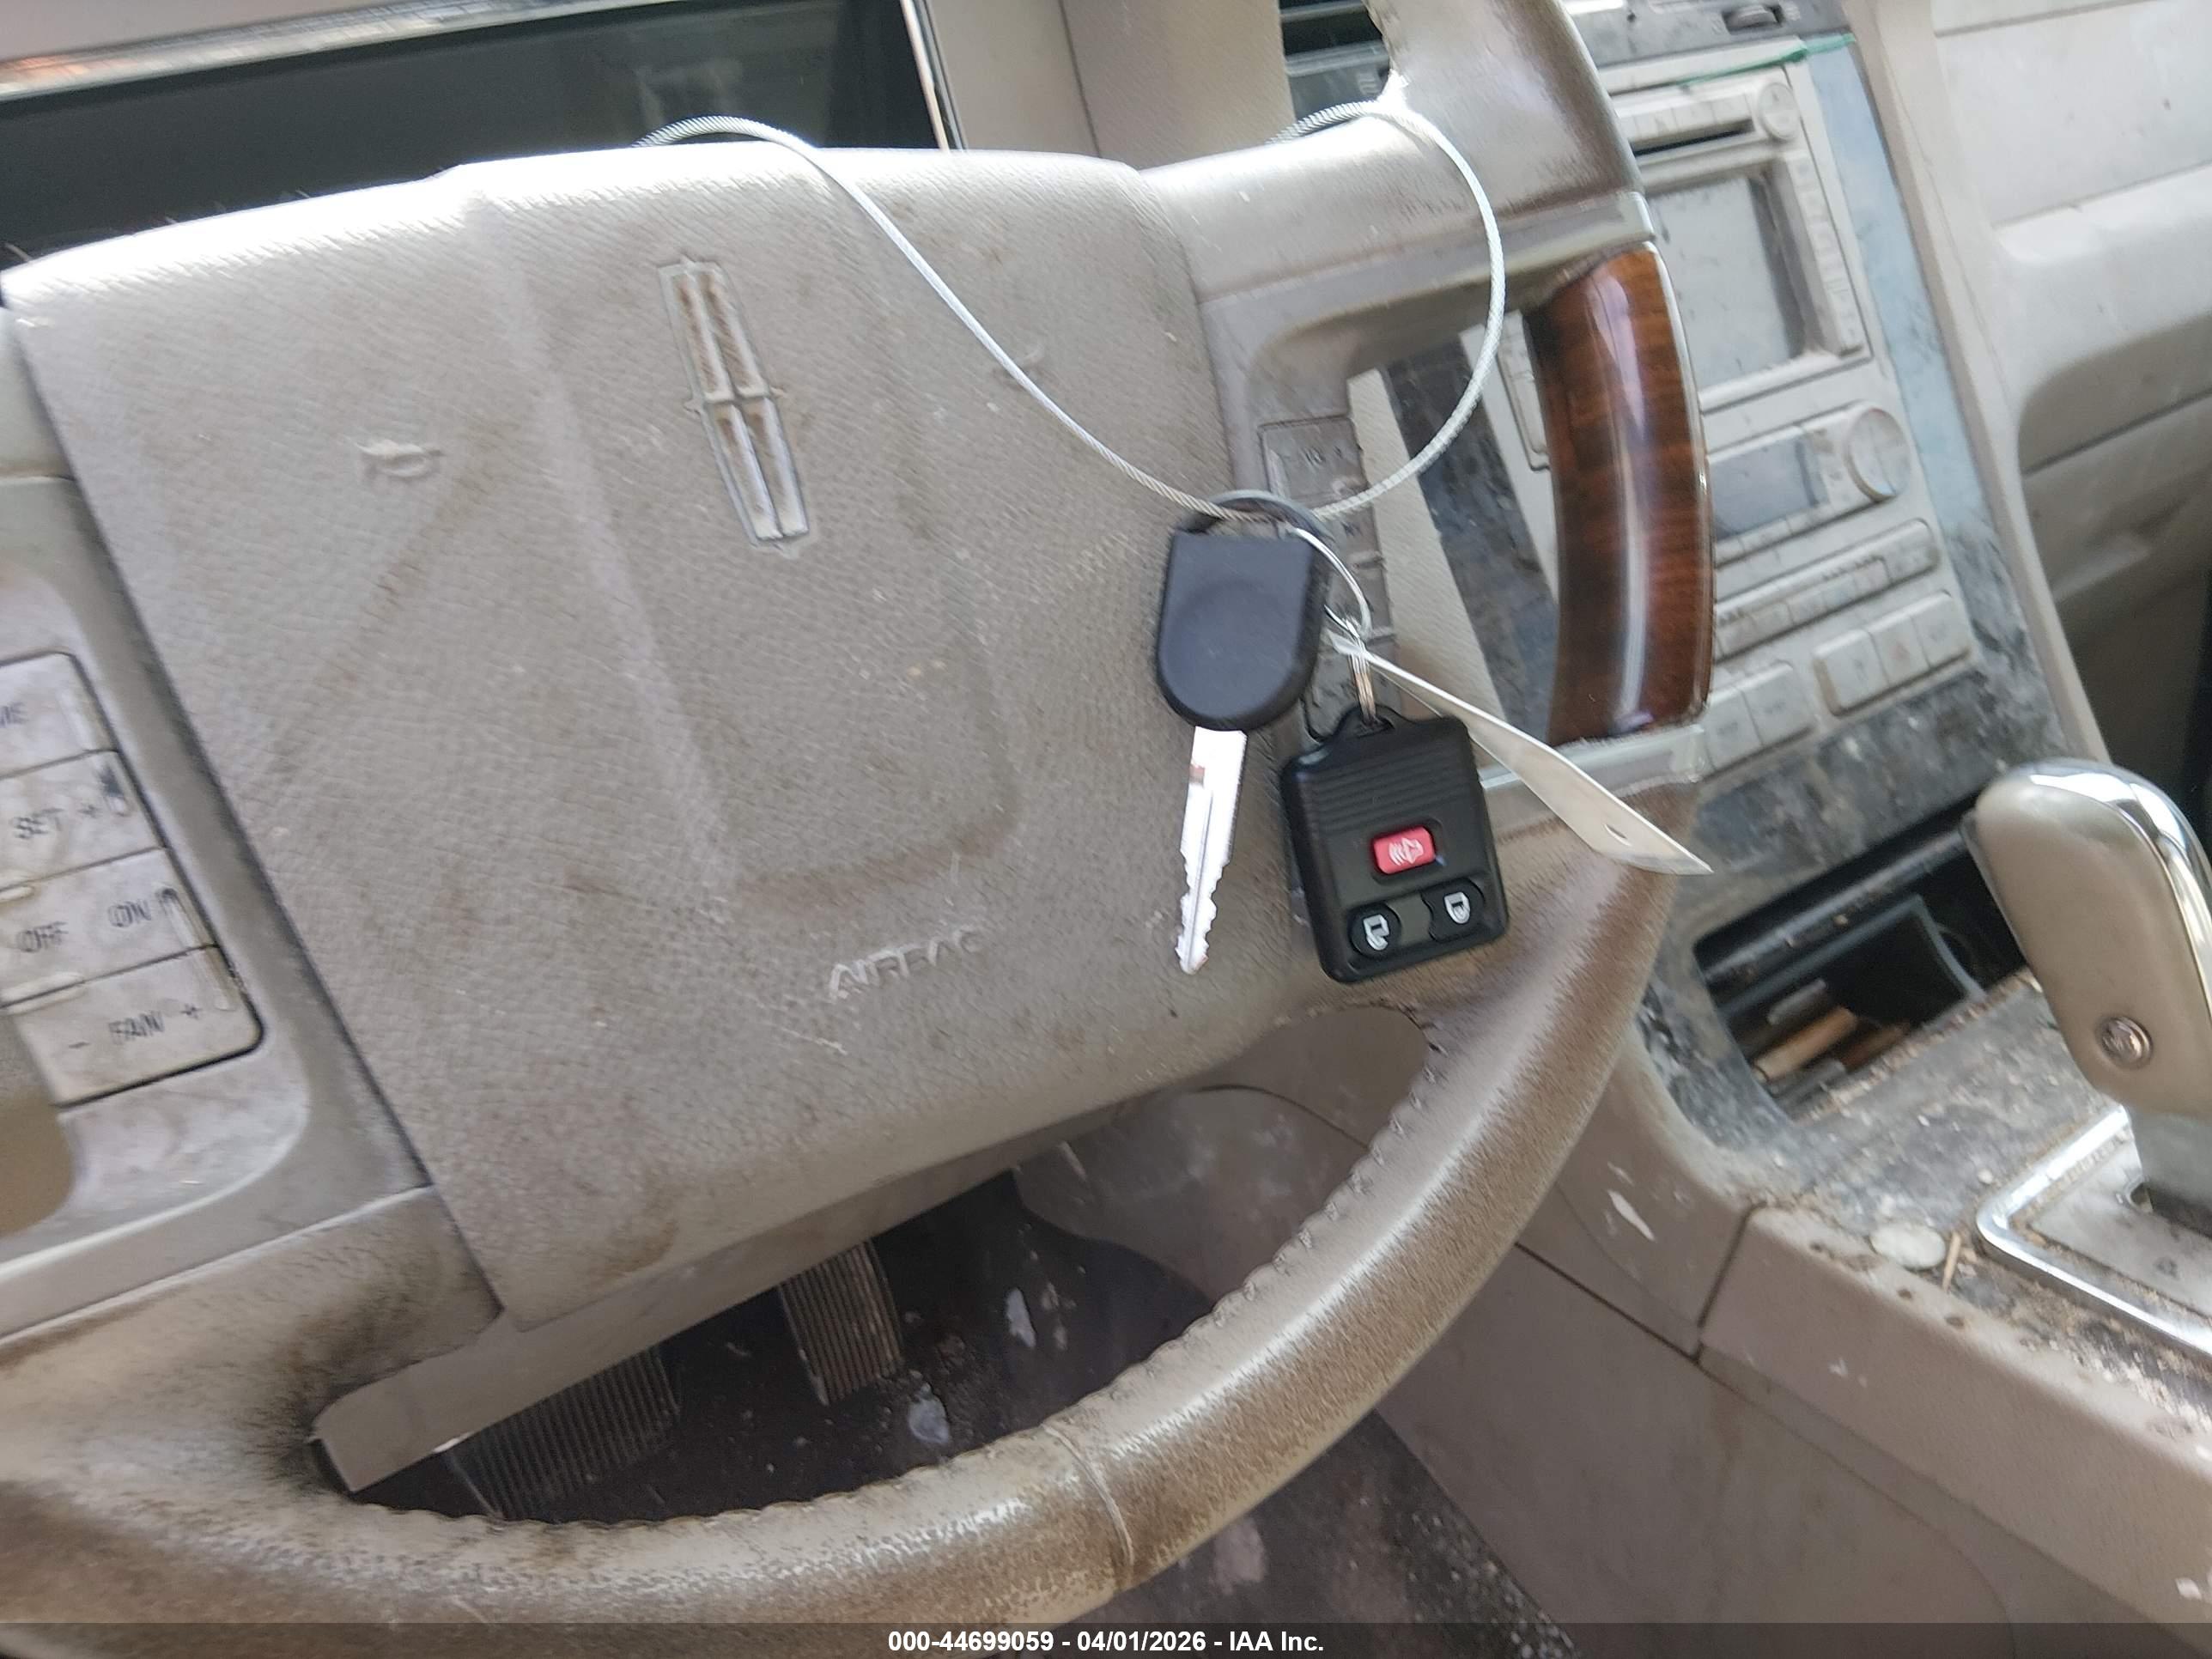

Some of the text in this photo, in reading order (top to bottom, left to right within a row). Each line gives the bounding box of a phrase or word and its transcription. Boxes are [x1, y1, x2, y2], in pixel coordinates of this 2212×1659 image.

[14, 807, 64, 839] SET
[108, 899, 152, 928] ON
[15, 921, 69, 953] OFF
[108, 1010, 166, 1046] FAN
